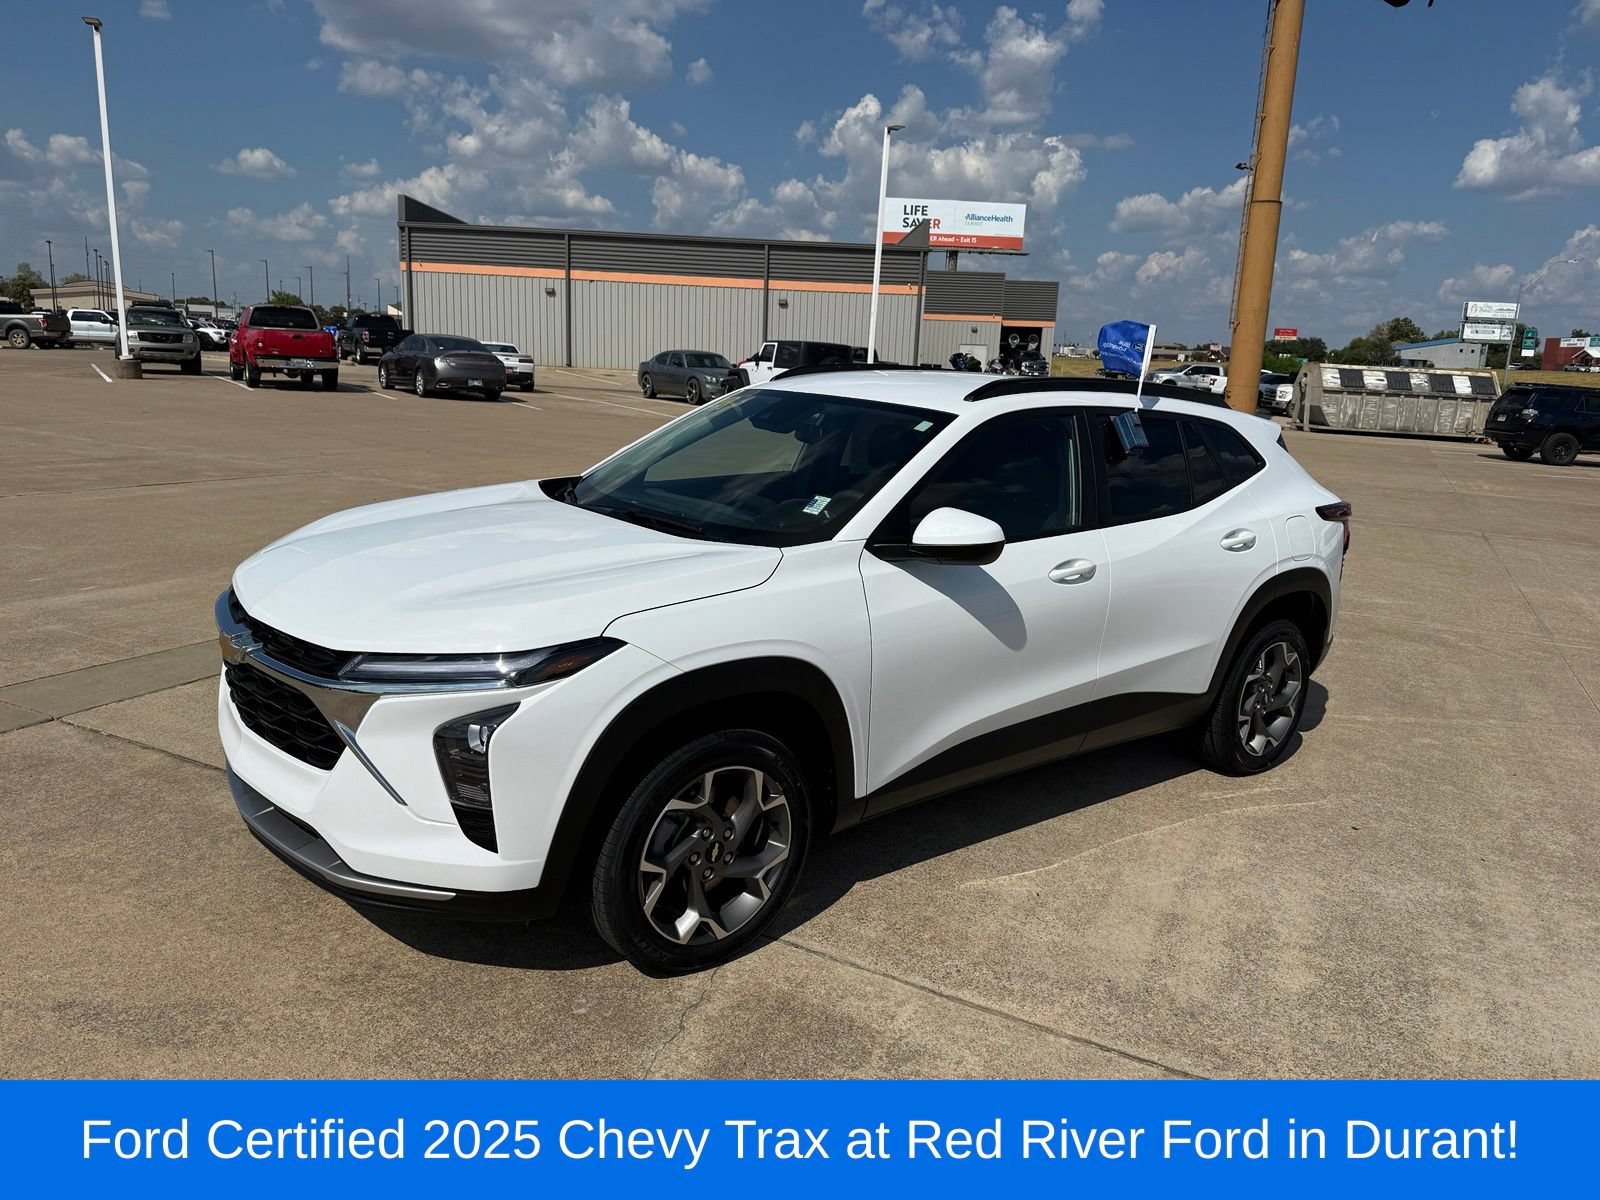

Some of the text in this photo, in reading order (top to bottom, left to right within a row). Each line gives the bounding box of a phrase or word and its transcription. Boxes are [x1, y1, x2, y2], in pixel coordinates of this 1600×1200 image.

[904, 204, 928, 216] LIFE
[964, 213, 1013, 222] AllianceHealth
[938, 235, 955, 243] Ahead
[960, 236, 971, 244] Exit
